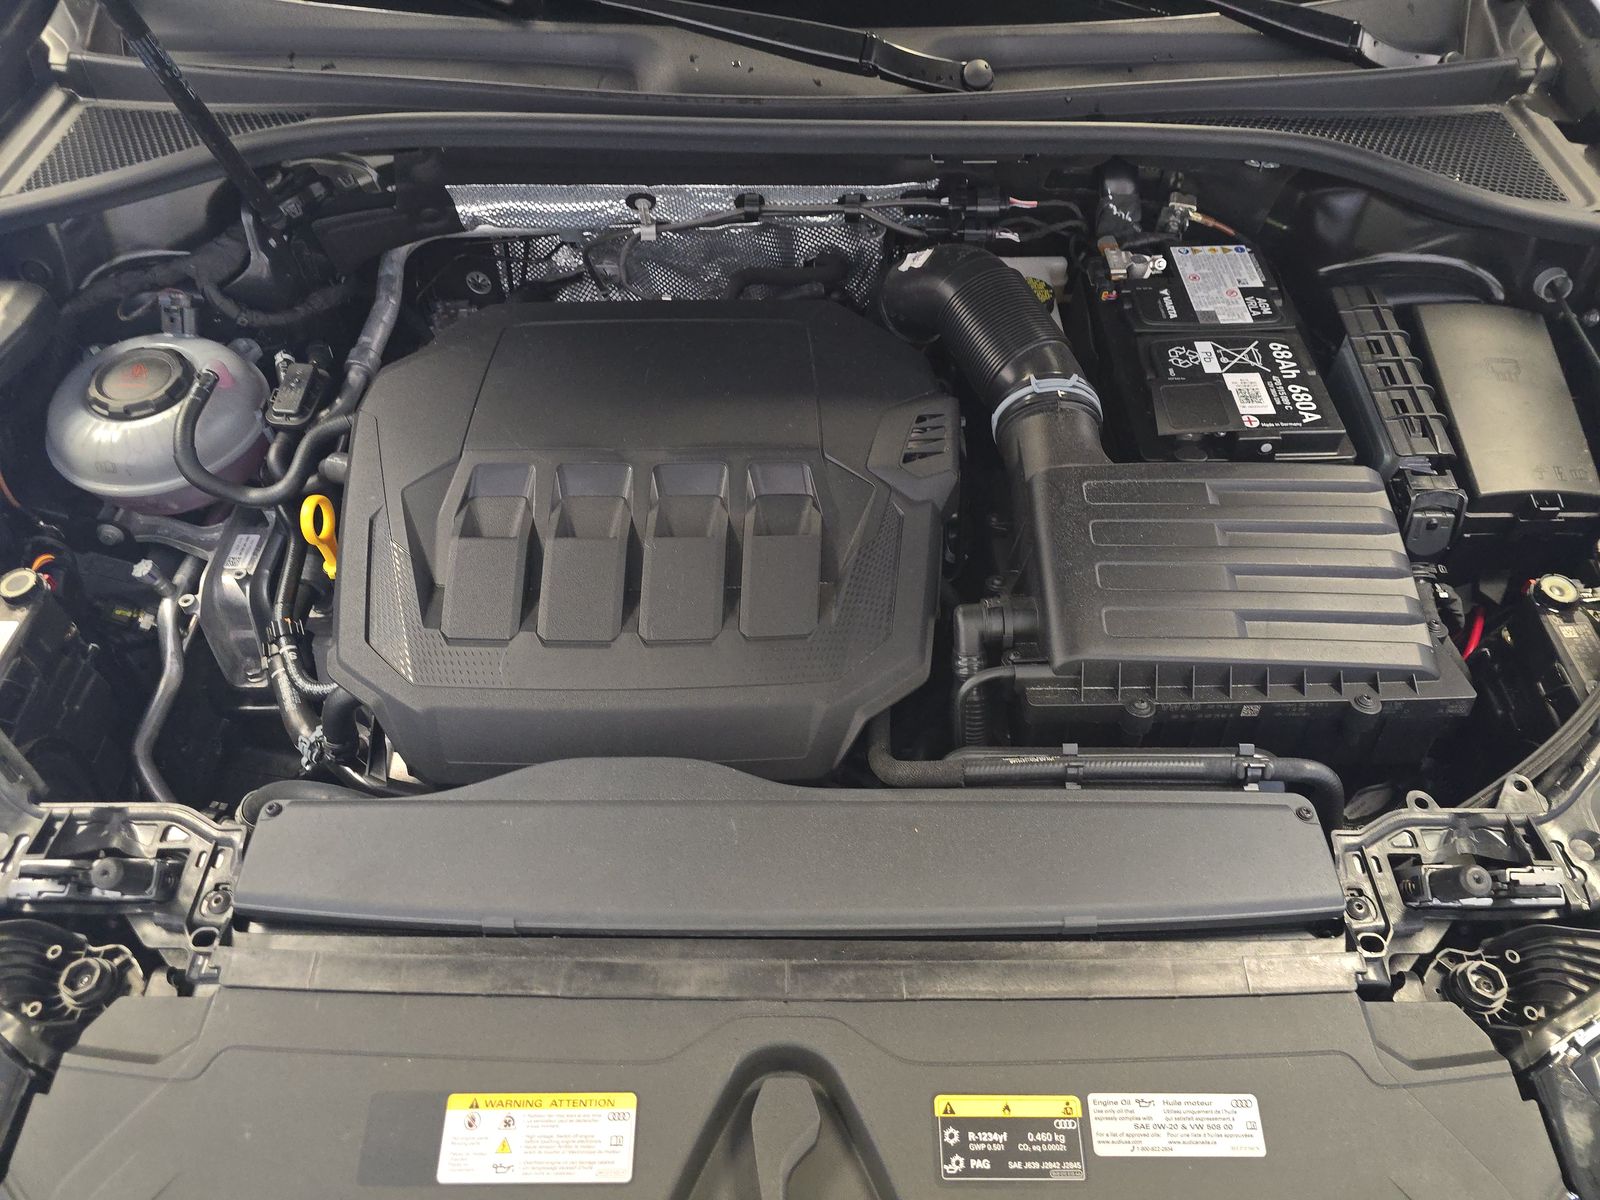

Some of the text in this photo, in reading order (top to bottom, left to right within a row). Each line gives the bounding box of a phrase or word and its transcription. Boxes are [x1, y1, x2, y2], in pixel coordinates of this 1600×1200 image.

[1163, 296, 1178, 319] VARTA
[1245, 296, 1261, 316] VRLA
[1256, 297, 1272, 315] AGM
[1202, 351, 1213, 363] Pb
[1269, 342, 1322, 423] 68Ah 680A
[484, 1099, 616, 1108] WARNING ATTENTION
[1092, 1099, 1119, 1107] Engine
[968, 1131, 1066, 1144] R-1234yf 0.460 kg
[969, 1143, 987, 1151] GWP
[987, 1143, 1005, 1151] 0.501
[970, 1158, 991, 1169] PAG
[1007, 1161, 1023, 1169] SAE
